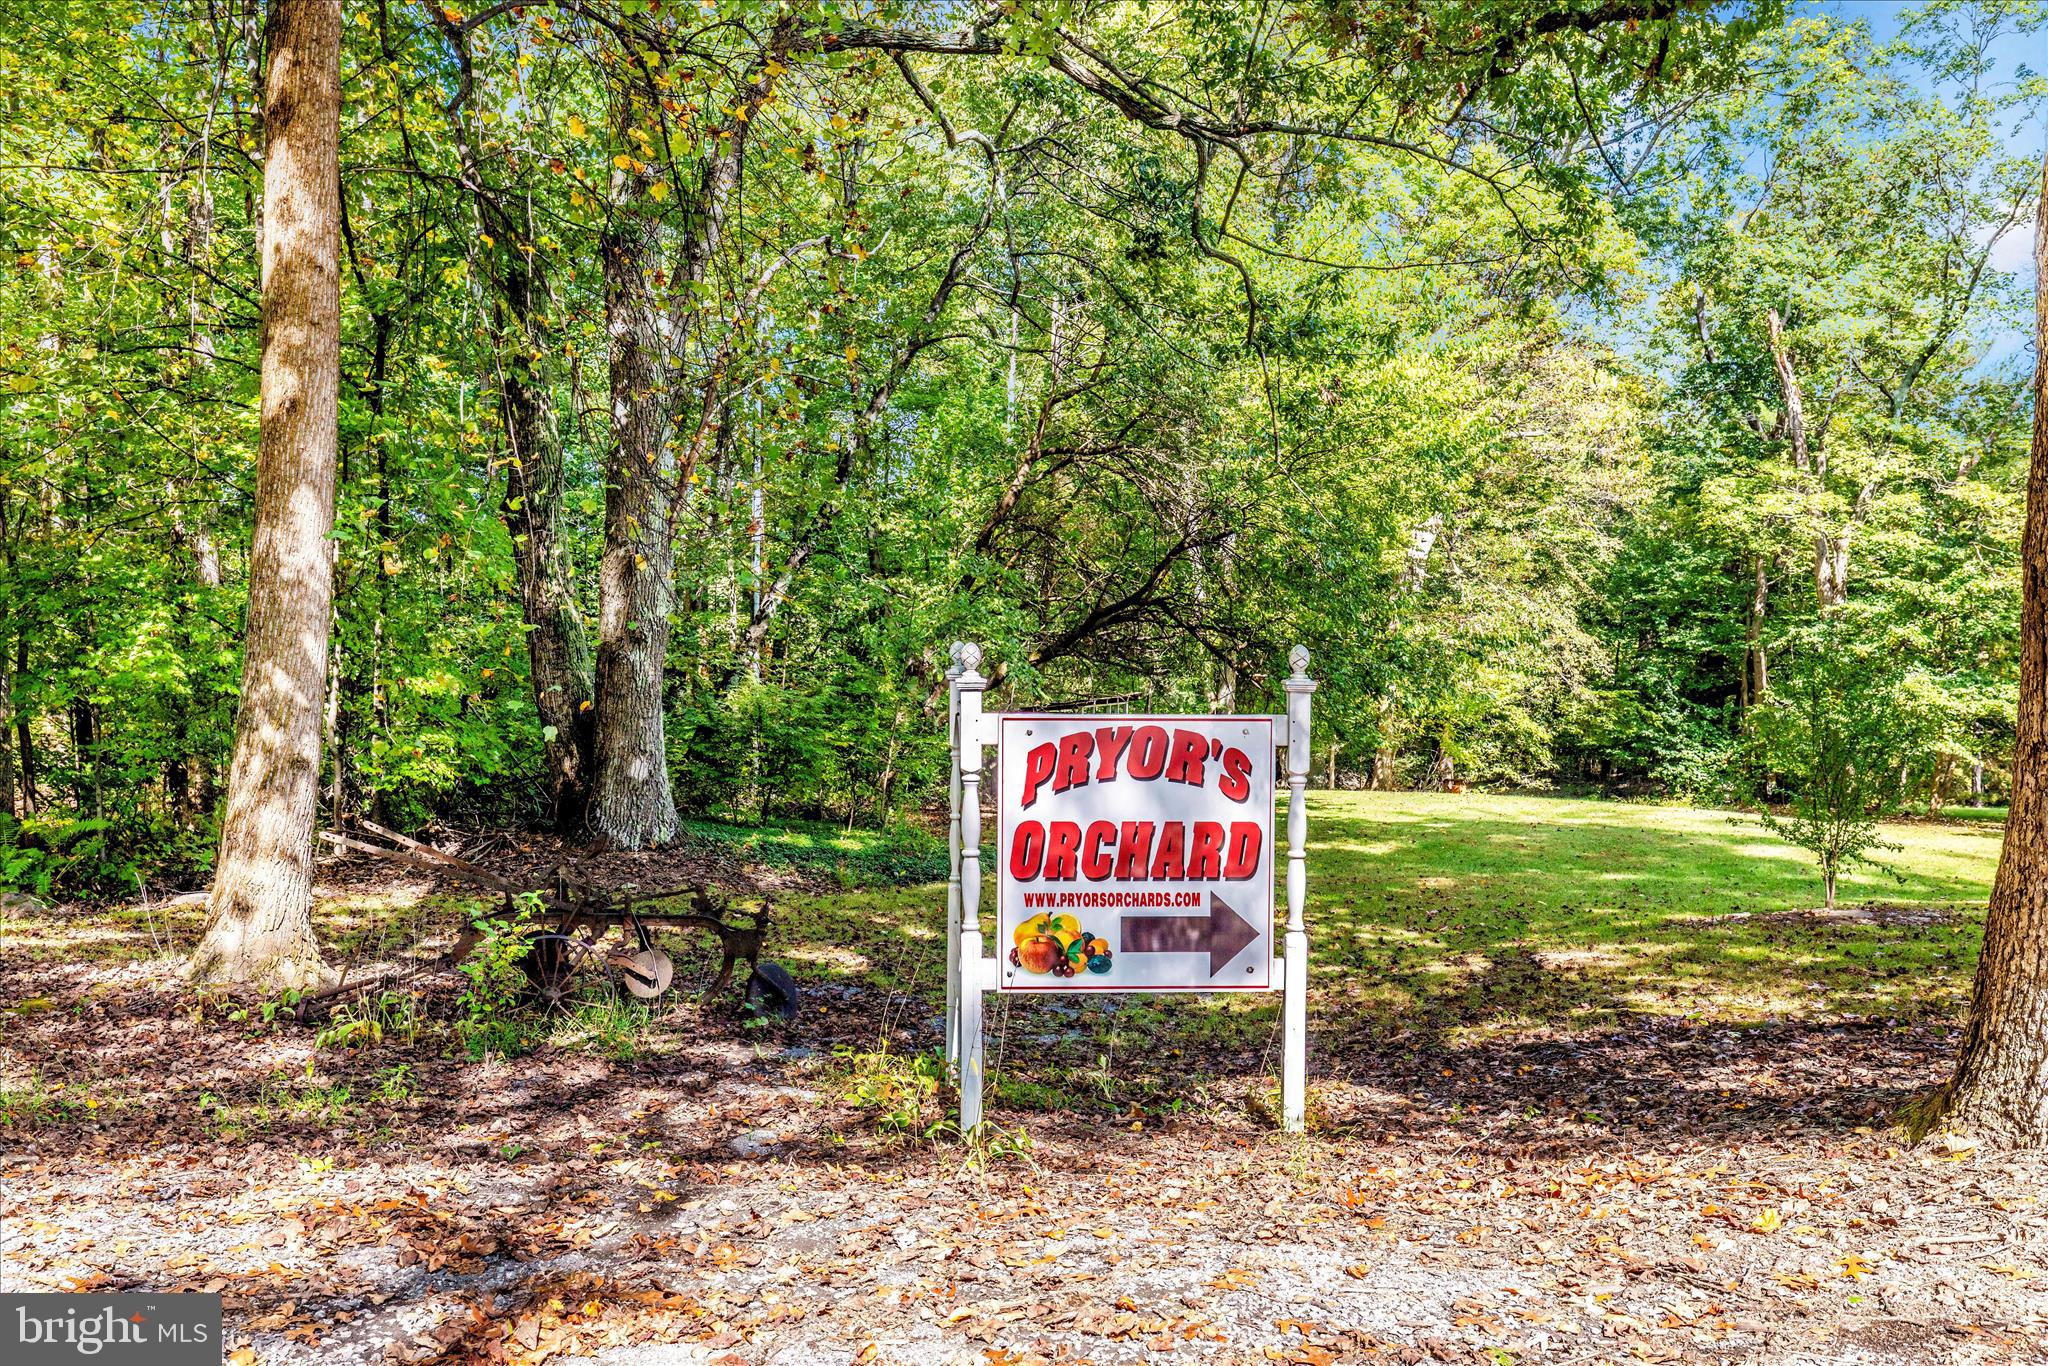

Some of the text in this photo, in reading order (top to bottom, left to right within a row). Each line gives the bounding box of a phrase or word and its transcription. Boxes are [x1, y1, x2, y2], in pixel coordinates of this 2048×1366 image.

[1021, 725, 1253, 810] PRYOR'S
[1010, 820, 1263, 882] ORCHARD
[1024, 892, 1201, 908] WWW.PRYORSORCHARDS.COM
